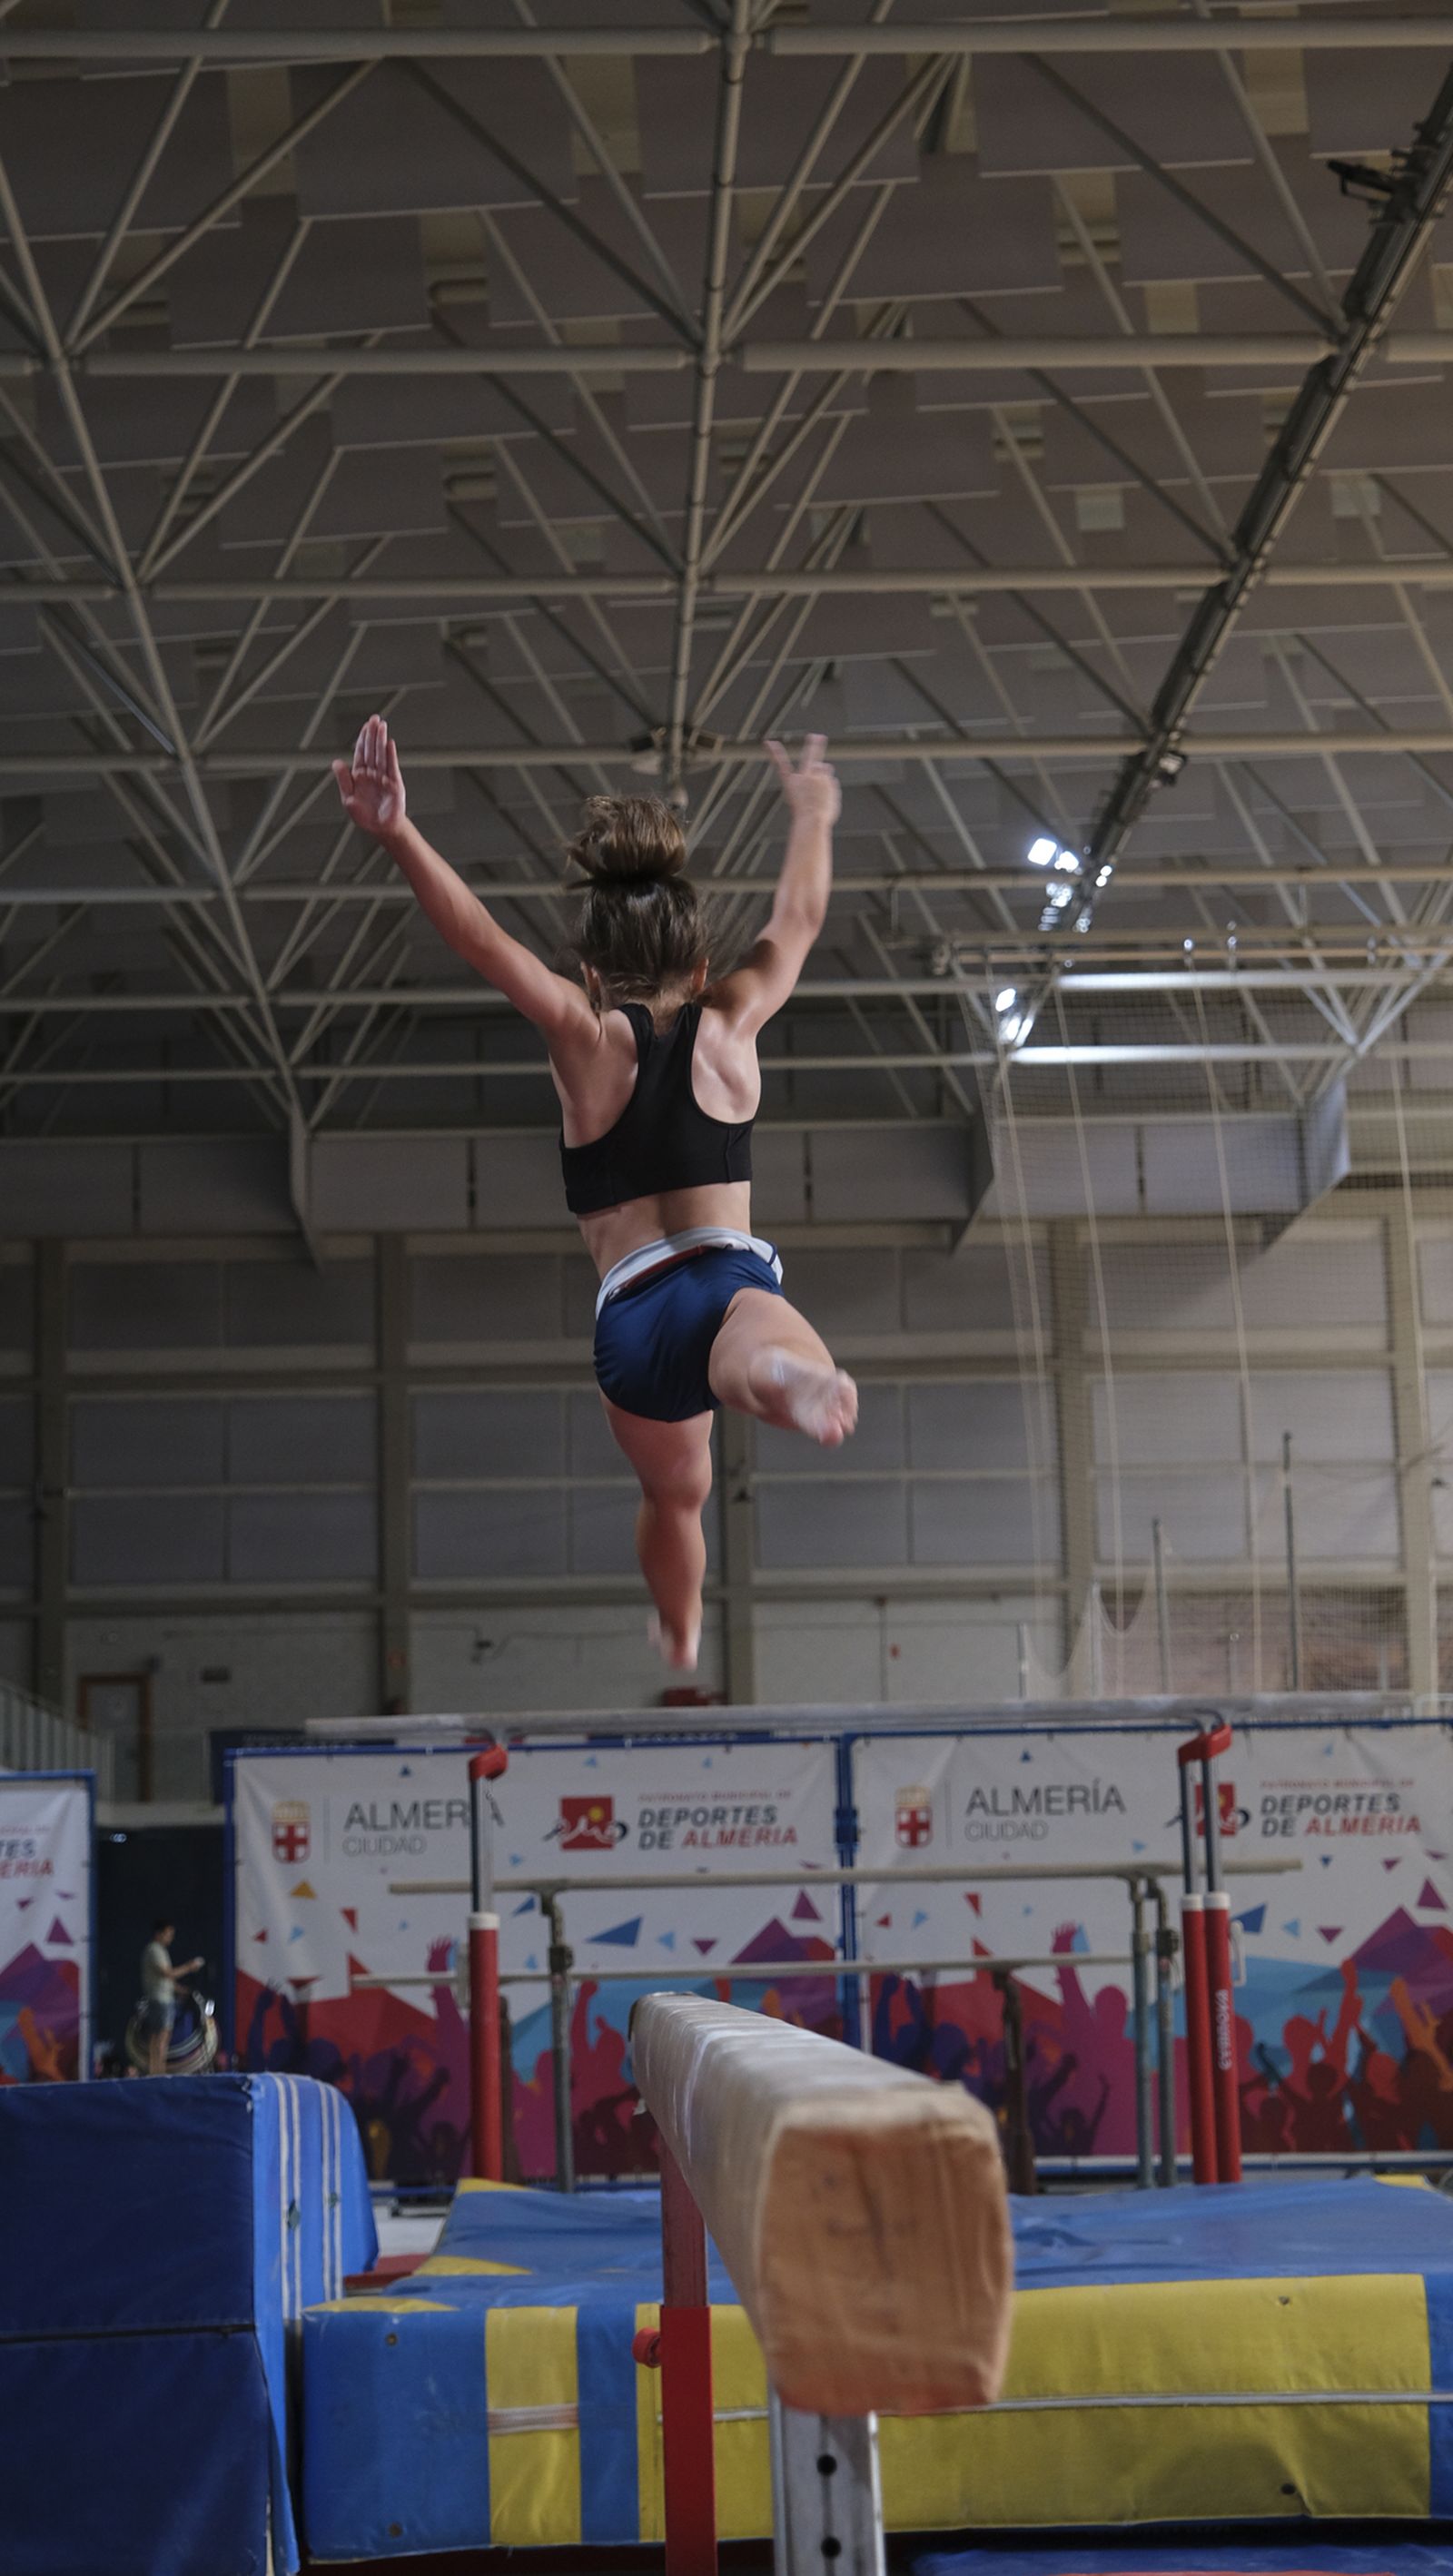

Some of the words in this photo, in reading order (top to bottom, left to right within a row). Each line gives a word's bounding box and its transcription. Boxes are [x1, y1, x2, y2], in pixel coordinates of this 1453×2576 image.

[965, 1777, 1127, 1816] ALMERÍA
[1260, 1792, 1401, 1815] DEPORTES
[638, 1804, 778, 1830] DEPORTES
[1260, 1817, 1296, 1838] DE
[1305, 1815, 1422, 1837] ALMERIA
[638, 1830, 675, 1851] DE
[682, 1825, 798, 1849] ALMERIA
[964, 1820, 1049, 1842] CIUDAD
[341, 1834, 428, 1857] CIUDAD
